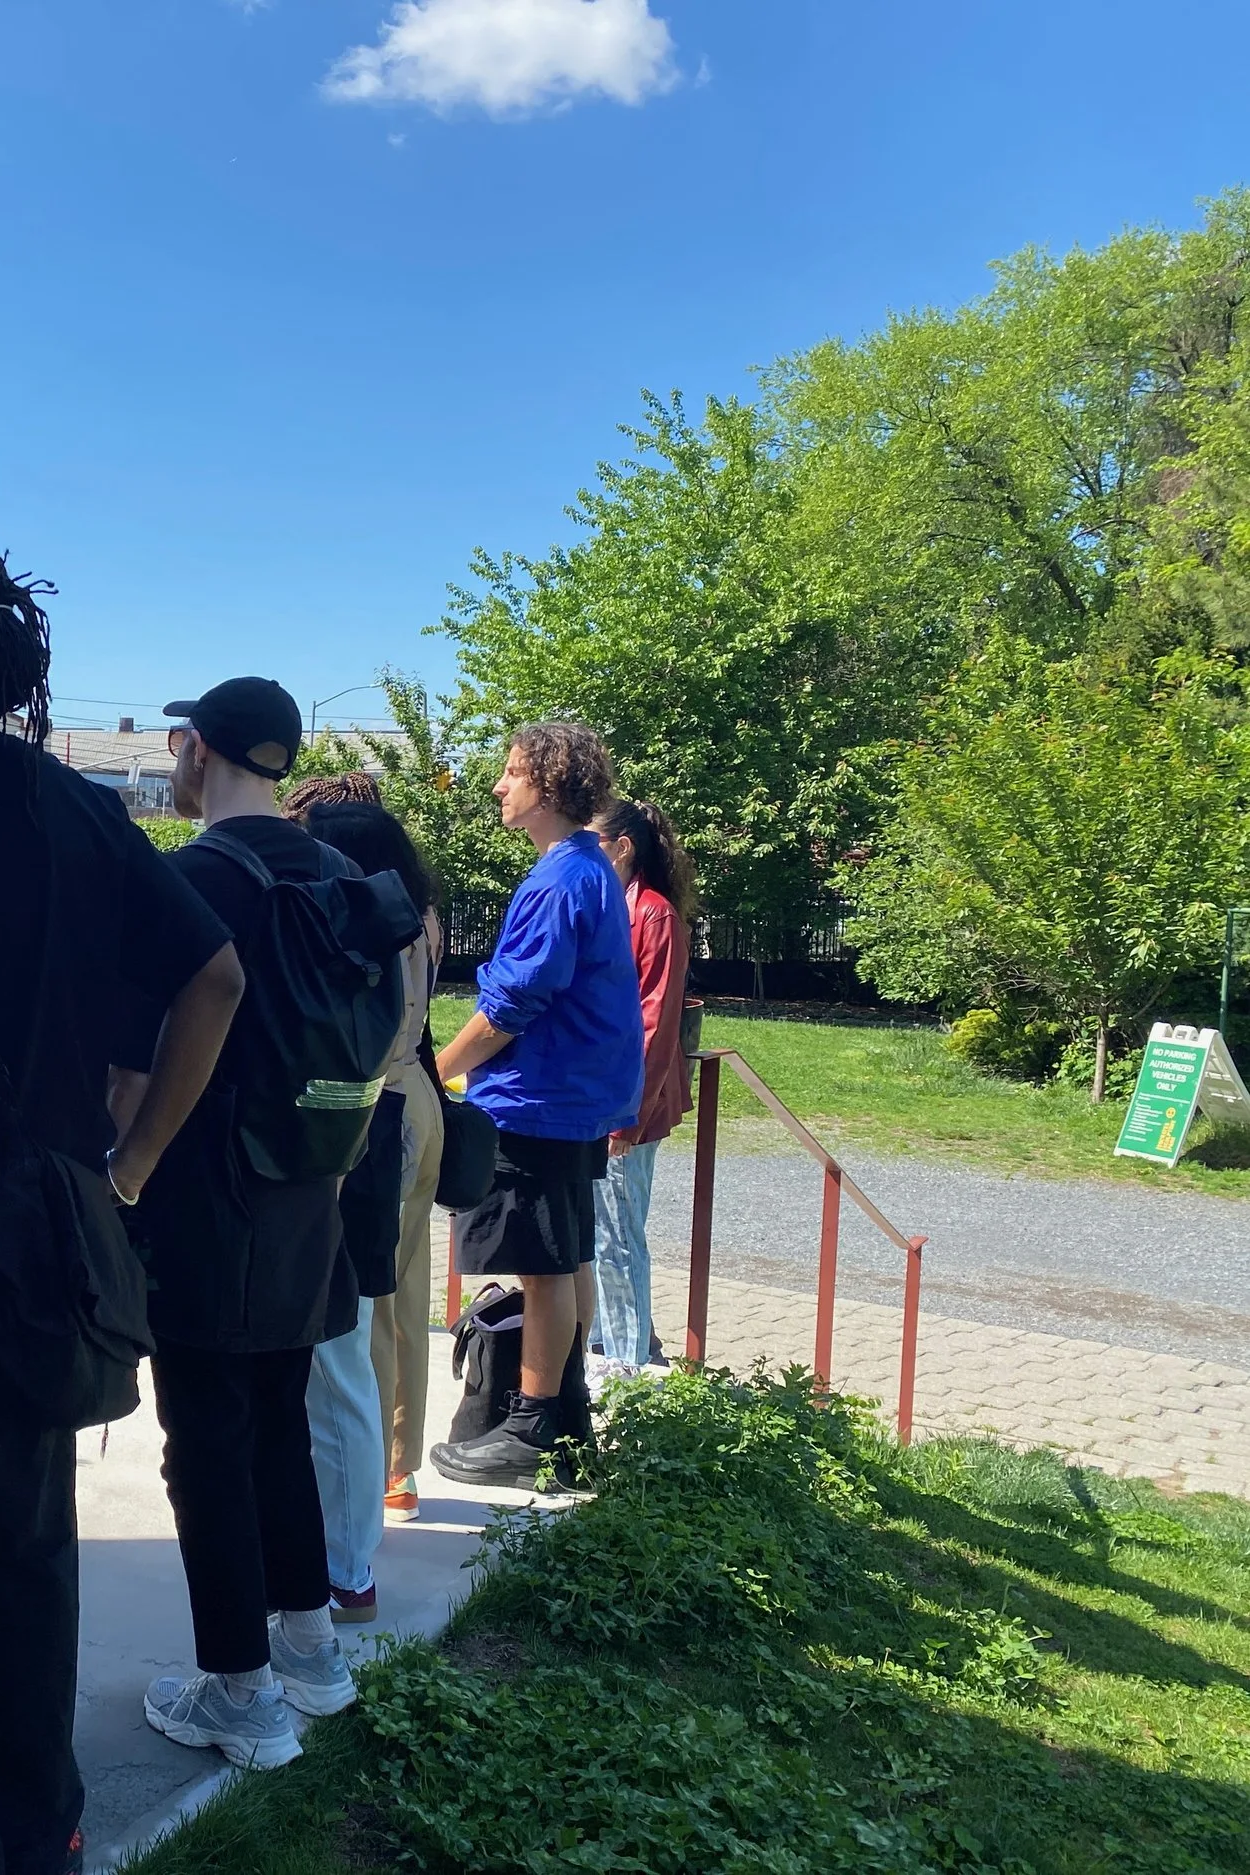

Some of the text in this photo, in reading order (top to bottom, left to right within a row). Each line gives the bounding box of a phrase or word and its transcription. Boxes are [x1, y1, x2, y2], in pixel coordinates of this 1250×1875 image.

[1153, 1048, 1196, 1060] NO PARKING
[1149, 1060, 1195, 1073] AUTHORIZED
[1152, 1070, 1186, 1082] VEHICLES
[1156, 1082, 1177, 1091] ONLY
